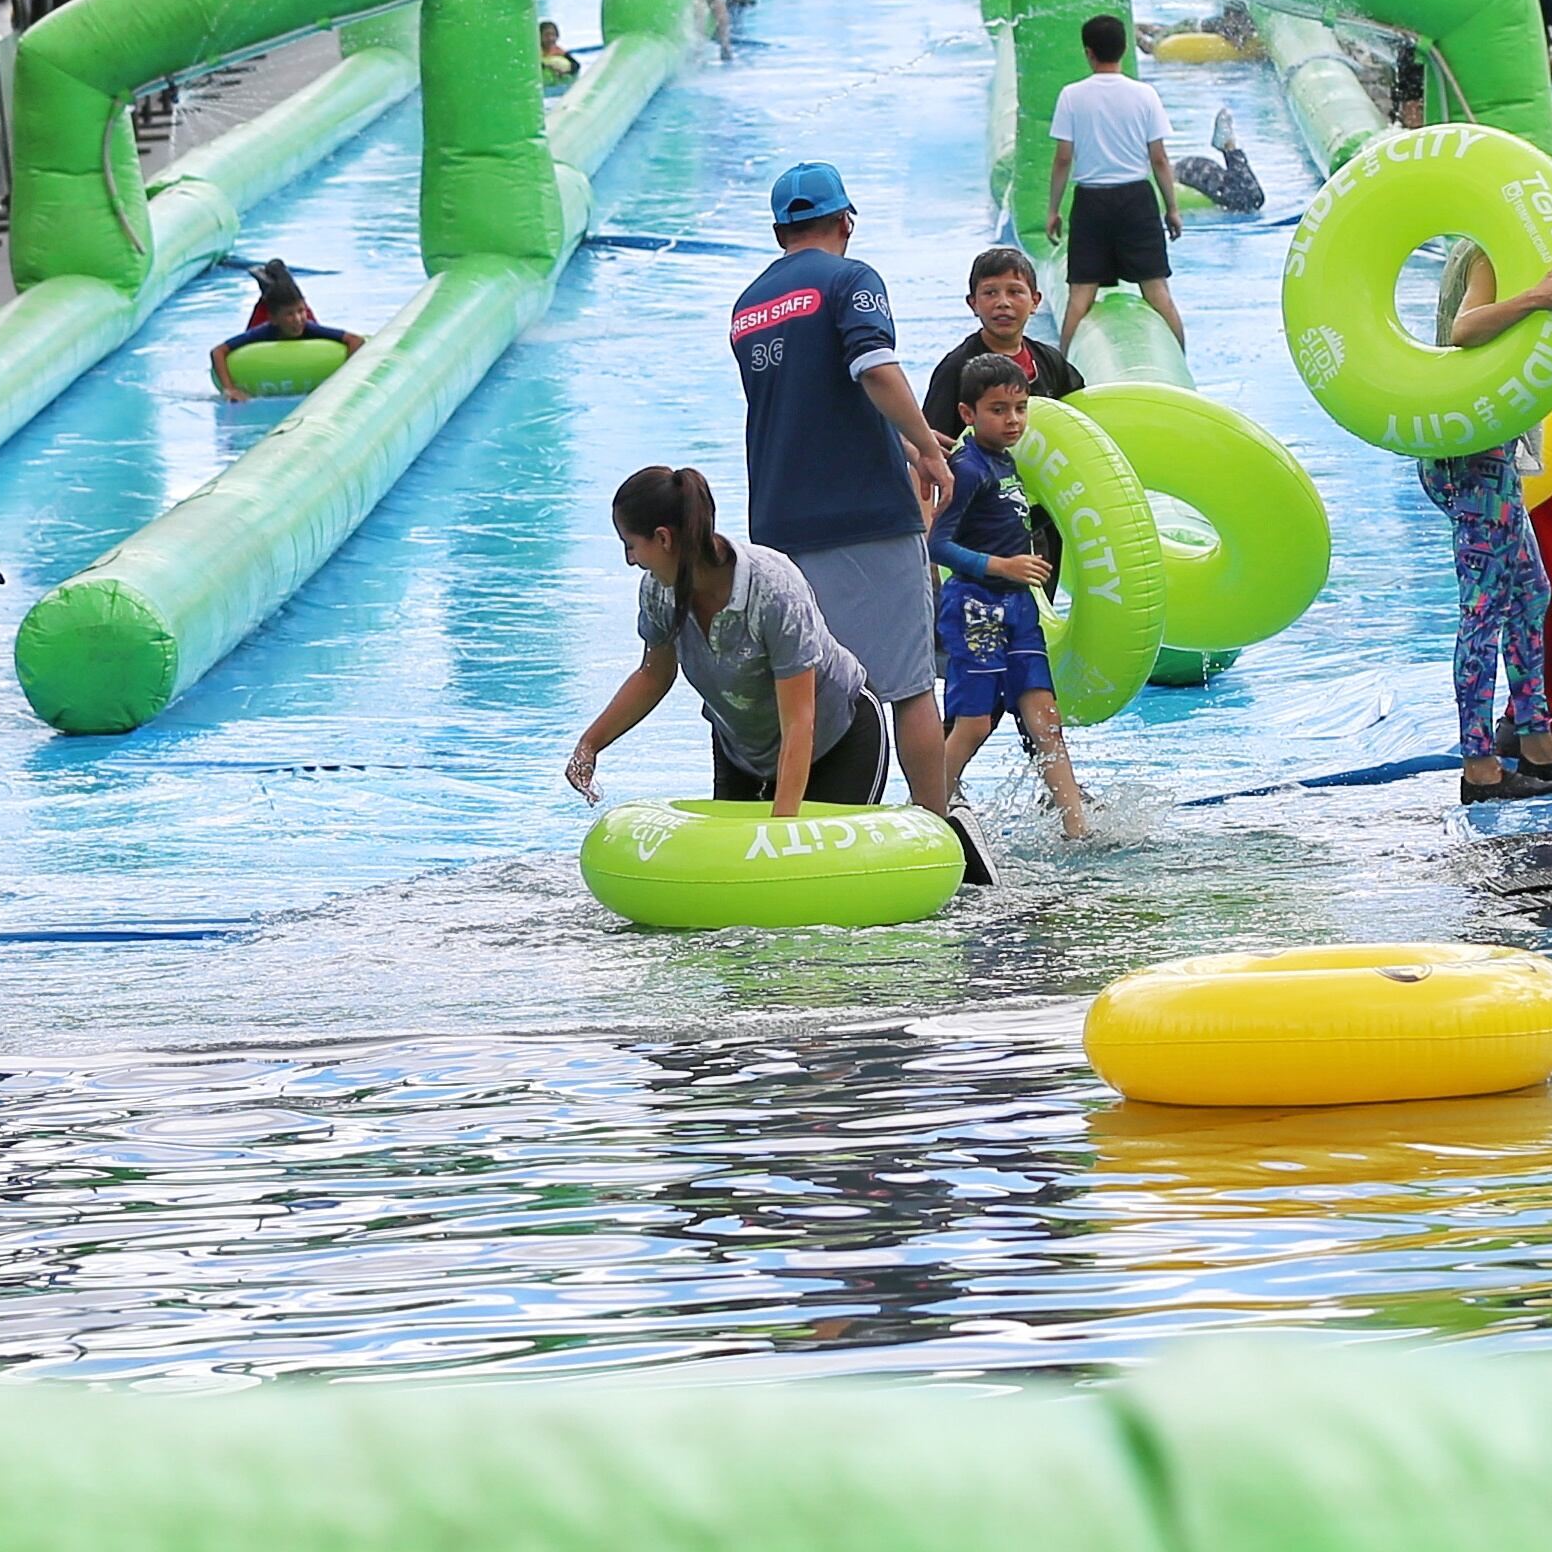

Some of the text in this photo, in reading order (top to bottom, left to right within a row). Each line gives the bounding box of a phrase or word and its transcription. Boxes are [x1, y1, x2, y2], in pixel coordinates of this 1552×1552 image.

[771, 295, 814, 320] STAFF
[751, 337, 785, 372] 36
[1057, 481, 1086, 509] the
